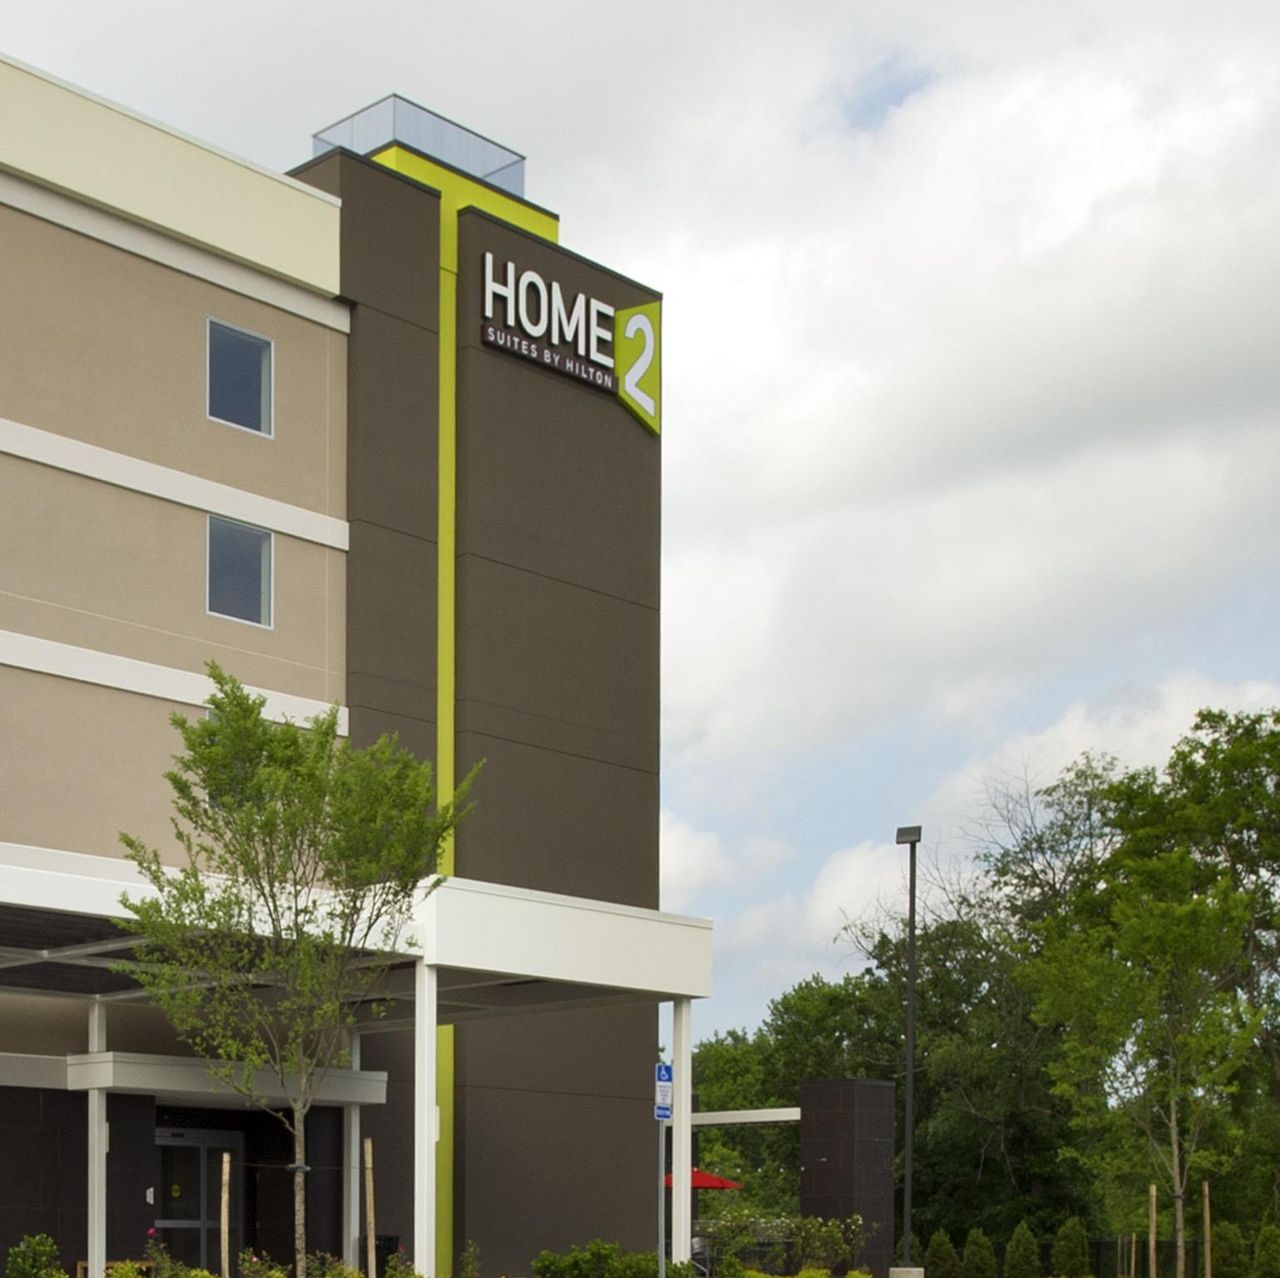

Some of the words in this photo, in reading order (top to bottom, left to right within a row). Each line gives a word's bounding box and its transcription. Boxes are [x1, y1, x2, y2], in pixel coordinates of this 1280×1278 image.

[487, 326, 539, 358] SUITES
[543, 349, 561, 367] BY
[565, 358, 612, 388] HILTON
